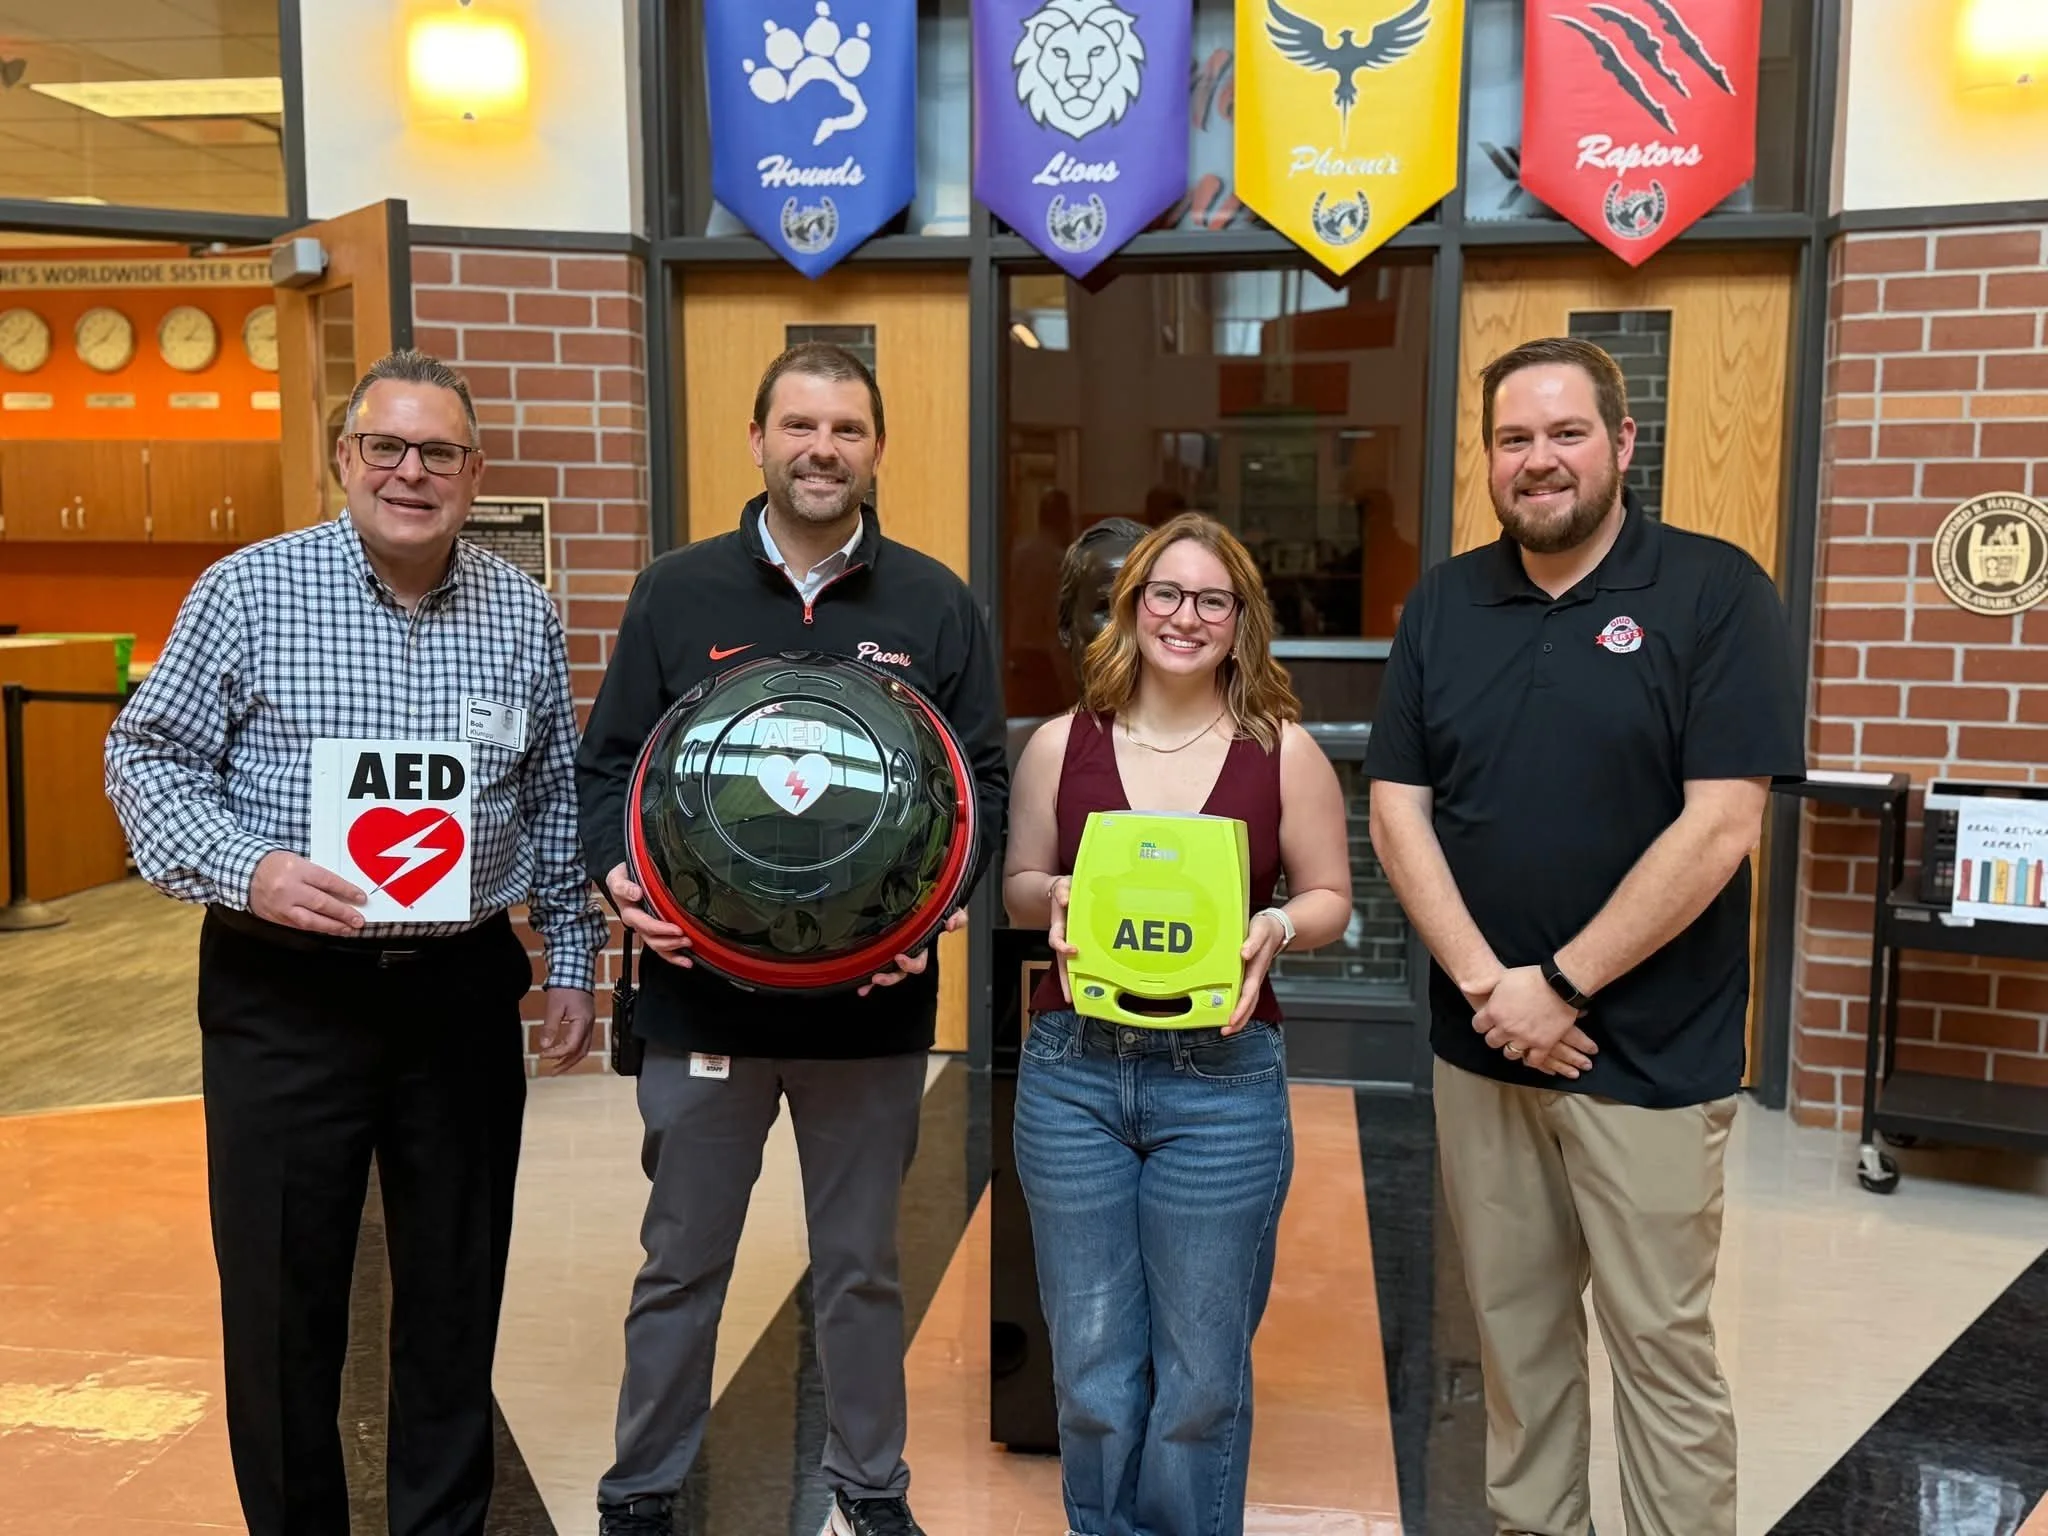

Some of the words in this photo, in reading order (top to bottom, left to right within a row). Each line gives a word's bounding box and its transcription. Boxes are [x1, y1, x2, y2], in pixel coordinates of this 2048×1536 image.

[757, 155, 867, 188] Hounds
[1031, 151, 1120, 186] Lions
[1288, 145, 1402, 179] Phoenix
[1575, 134, 1703, 177] Raptors
[42, 264, 163, 284] WORLDWIDE
[169, 263, 232, 282] SISTER
[856, 641, 912, 667] Pacers
[470, 720, 484, 729] Bob
[760, 721, 828, 748] AED
[347, 752, 466, 801] AED
[1112, 918, 1193, 954] AED
